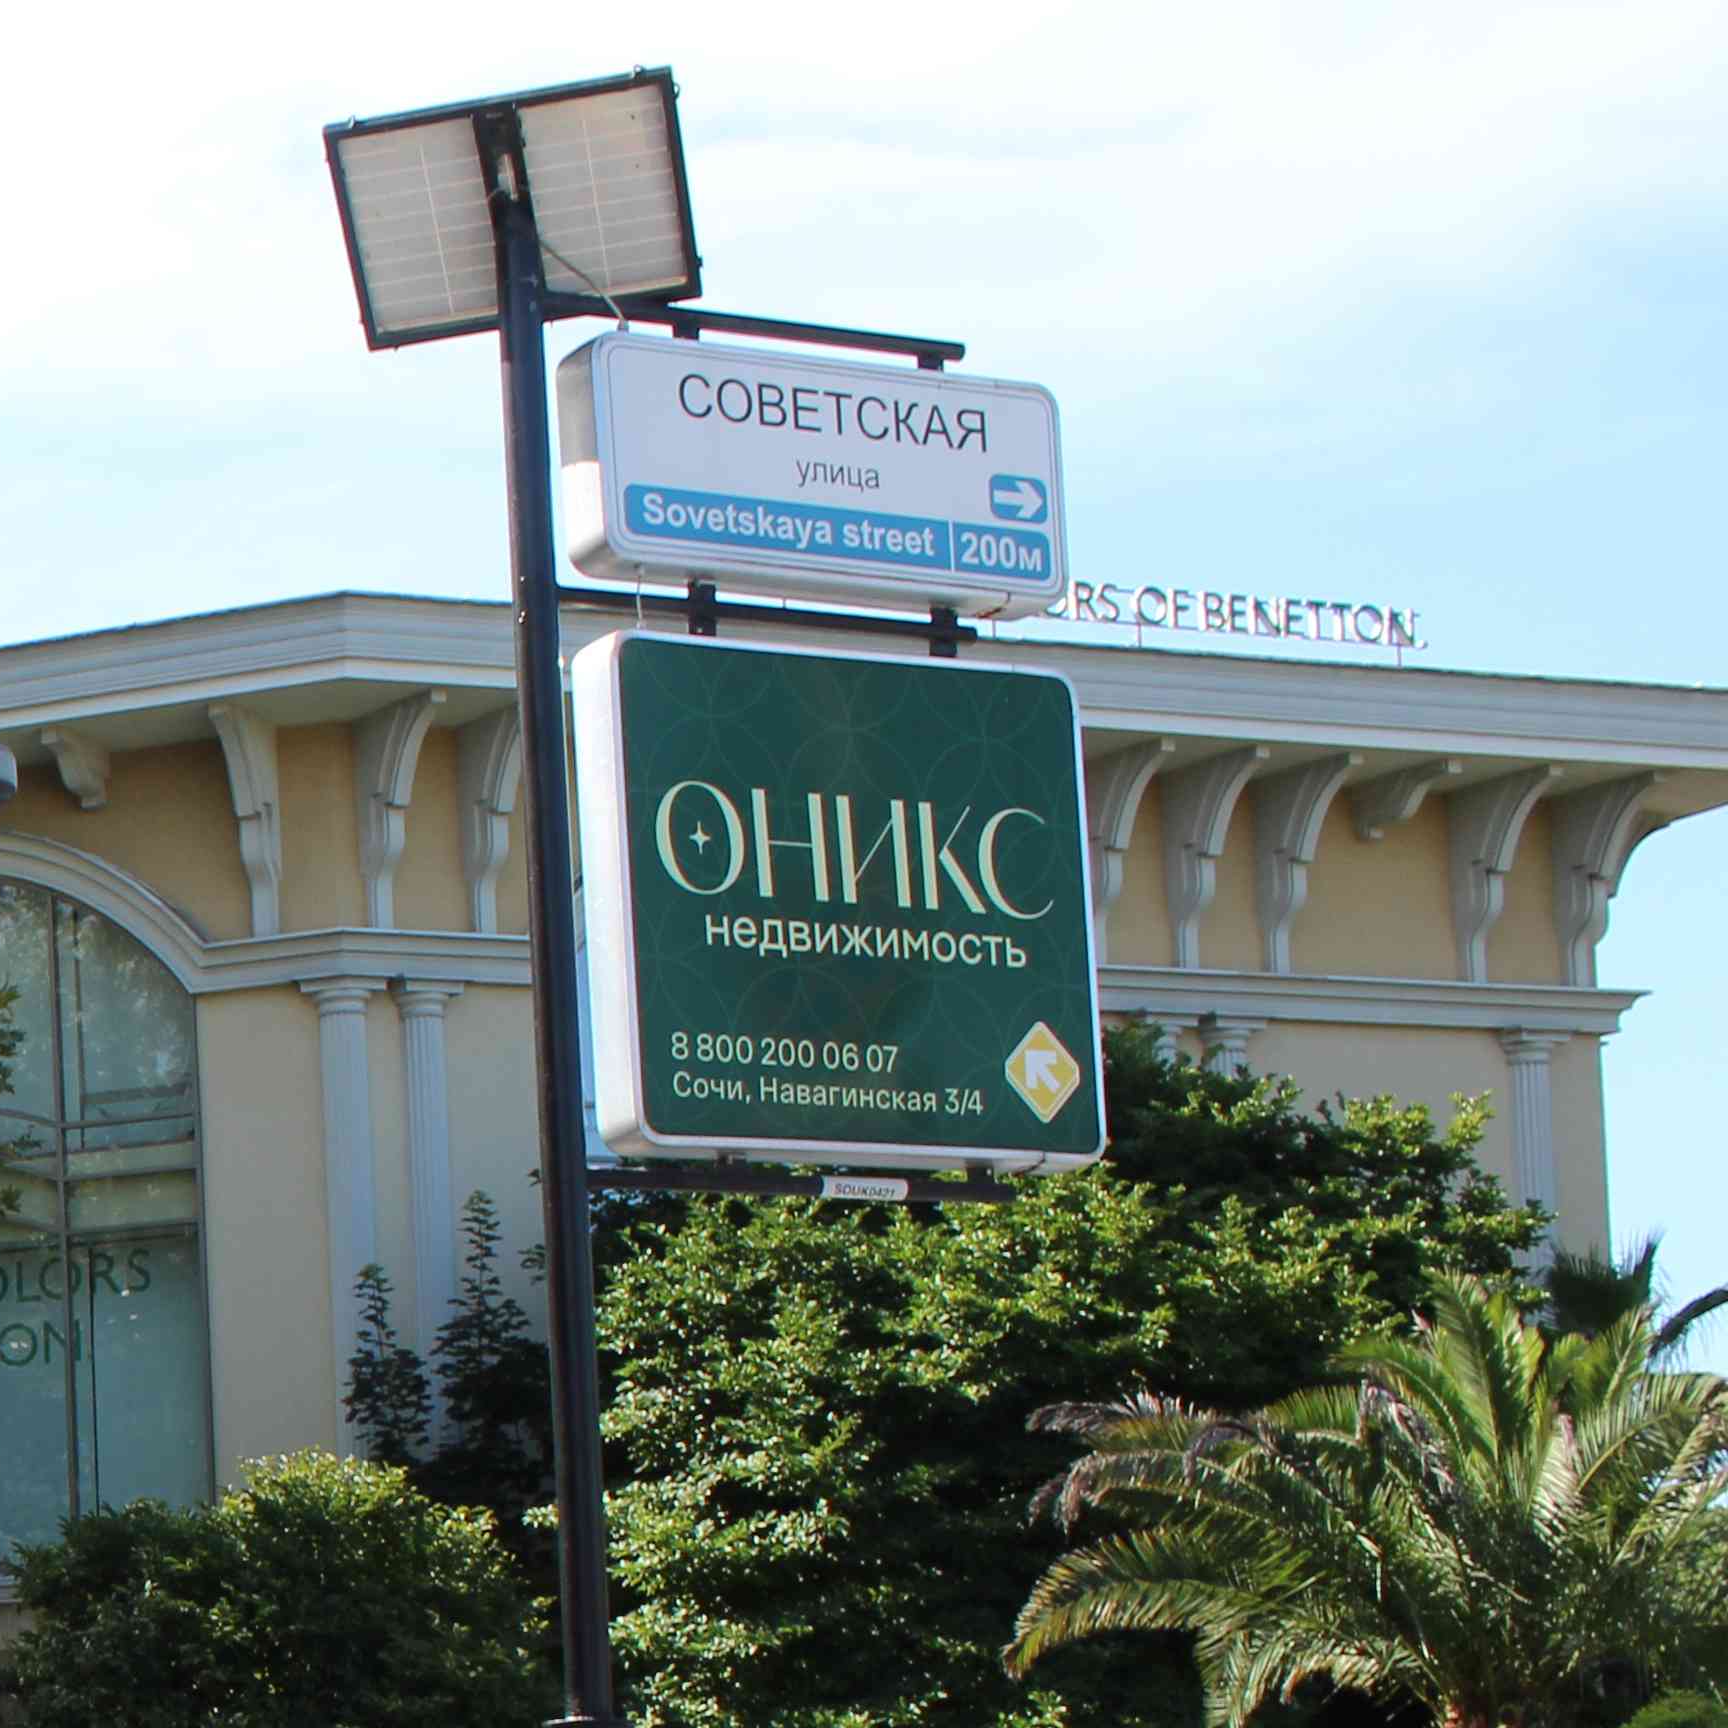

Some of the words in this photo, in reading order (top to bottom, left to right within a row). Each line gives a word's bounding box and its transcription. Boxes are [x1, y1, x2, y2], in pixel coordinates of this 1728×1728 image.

[678, 373, 989, 453] СОВЕТСКАЯ
[795, 457, 881, 494] улица
[642, 493, 834, 549] Sovetskaya
[842, 521, 935, 557] street
[959, 530, 1043, 573] 200м
[1136, 585, 1190, 628] OF
[655, 780, 1055, 921] ОНИКС
[704, 913, 1028, 969] недвижимость
[671, 1031, 689, 1061] 8
[696, 1033, 754, 1065] 800
[760, 1037, 815, 1069] 200
[822, 1041, 859, 1072] 06
[866, 1044, 898, 1073] 07
[673, 1071, 751, 1105] Сочи,
[759, 1076, 938, 1112] Навагинская
[944, 1087, 984, 1116] 3/4
